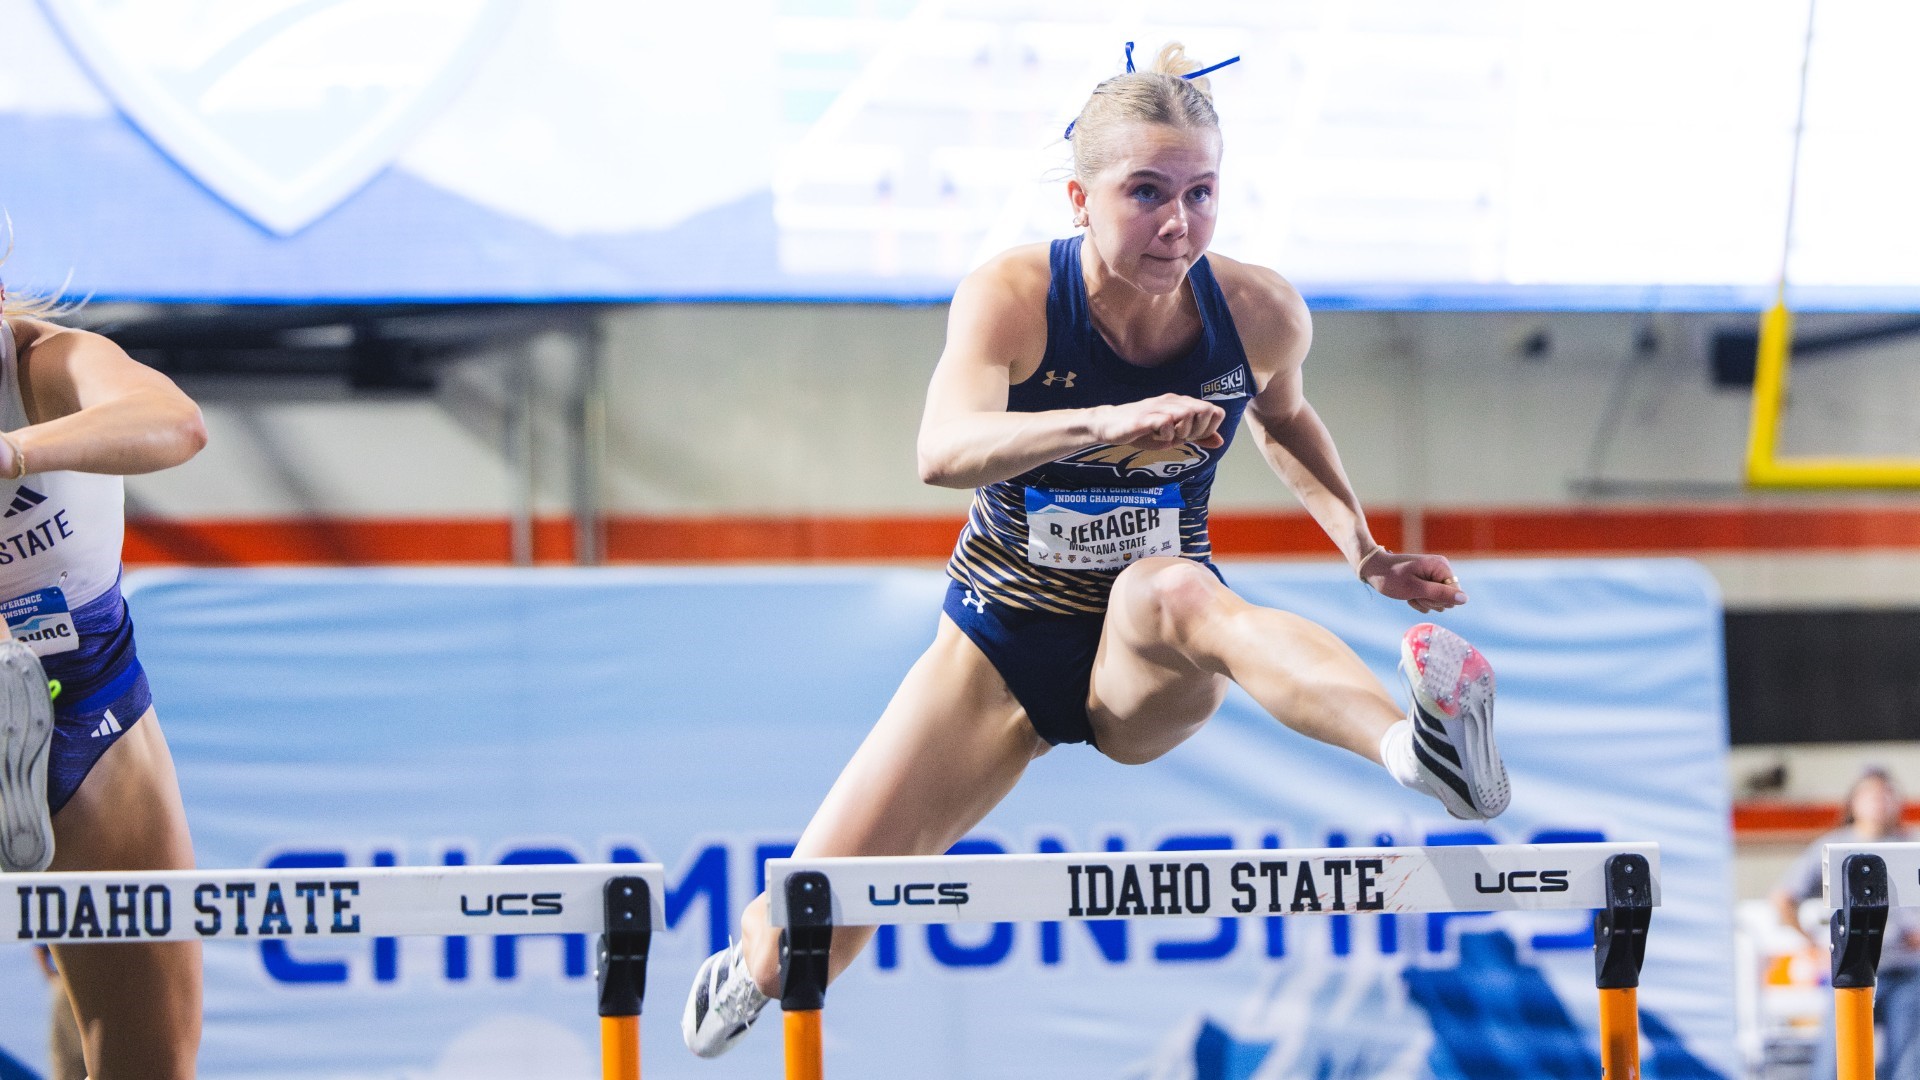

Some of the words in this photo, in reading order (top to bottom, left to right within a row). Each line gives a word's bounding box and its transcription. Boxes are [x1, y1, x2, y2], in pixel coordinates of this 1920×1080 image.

[1055, 495, 1087, 503] INDOOR
[1090, 495, 1157, 504] CHAMPIONSHIPS
[0, 508, 74, 565] STATE
[1119, 535, 1147, 552] STATE
[1067, 862, 1210, 917] IDAHO
[1229, 859, 1384, 913] STATE
[1474, 870, 1569, 893] UCS
[460, 893, 564, 916] UCS
[868, 883, 969, 906] UCS
[16, 884, 172, 940] IDAHO
[194, 881, 361, 935] STATE
